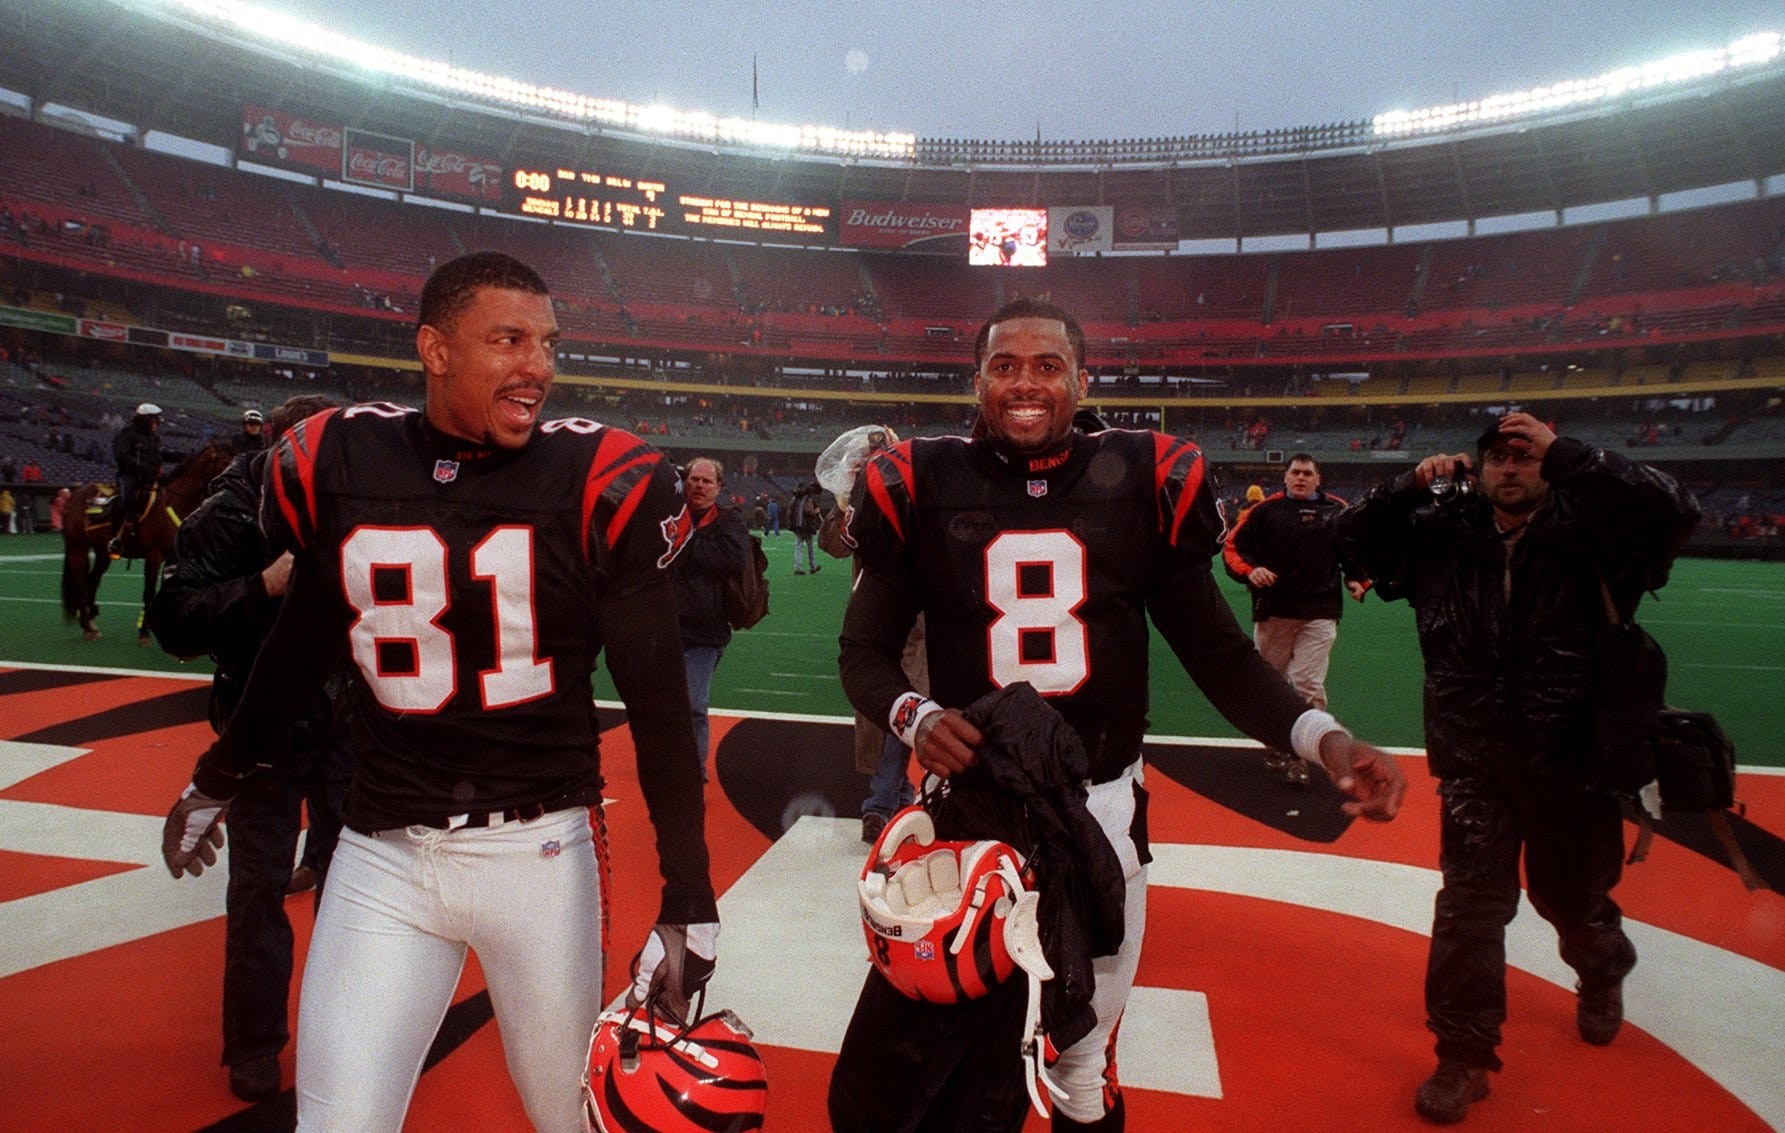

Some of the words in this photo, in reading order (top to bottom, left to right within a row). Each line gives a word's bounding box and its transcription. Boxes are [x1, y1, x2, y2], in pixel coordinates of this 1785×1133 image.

[515, 170, 550, 192] 0:00
[847, 209, 962, 230] Budweiser
[341, 524, 555, 715] 81
[984, 528, 1091, 696] 8
